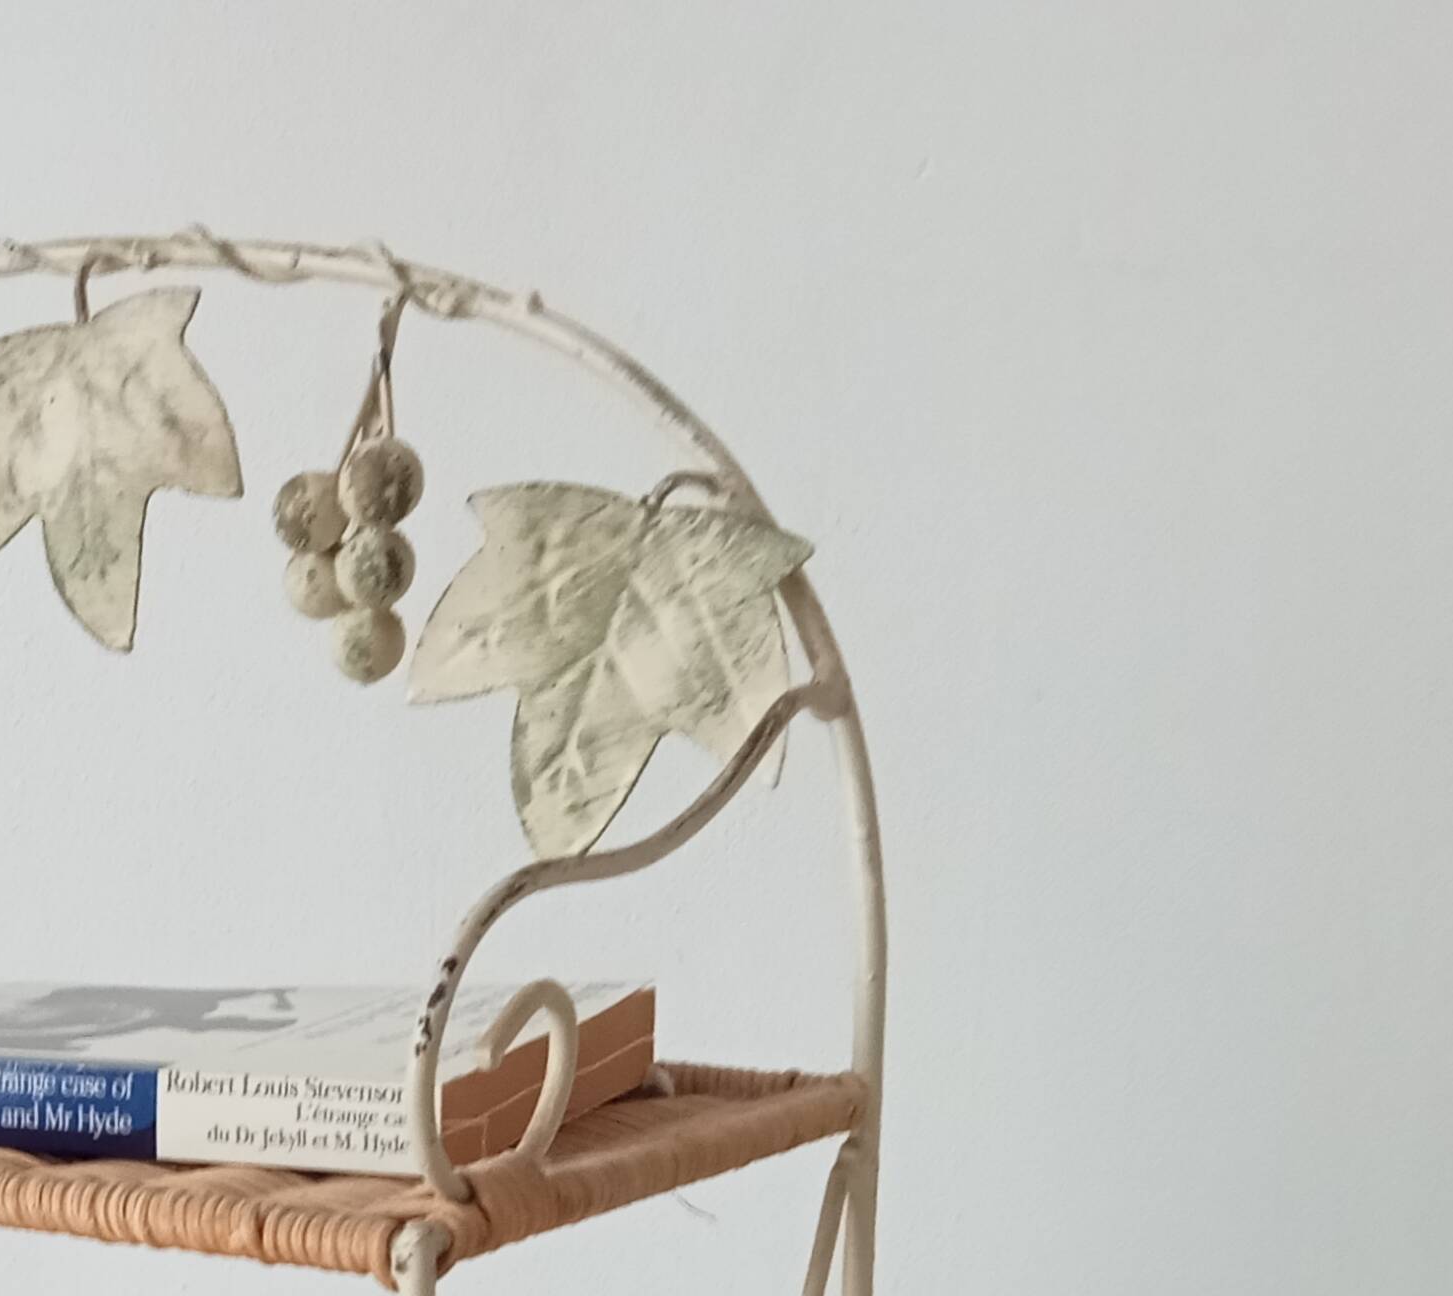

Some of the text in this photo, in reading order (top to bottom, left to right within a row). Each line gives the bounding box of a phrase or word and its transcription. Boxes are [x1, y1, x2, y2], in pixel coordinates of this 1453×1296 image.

[61, 1076, 107, 1099] case
[111, 1072, 133, 1101] of
[166, 1069, 234, 1096] Robert
[242, 1072, 299, 1098] Louis
[1, 1102, 38, 1129] and
[45, 1103, 73, 1131] Mr
[78, 1103, 133, 1139] Hyde
[296, 1102, 379, 1129] L'étrange
[207, 1124, 230, 1143] du
[235, 1126, 256, 1144] Dr
[260, 1127, 307, 1153] Jekyll
[312, 1135, 328, 1148] et
[363, 1132, 410, 1158] Hyde
